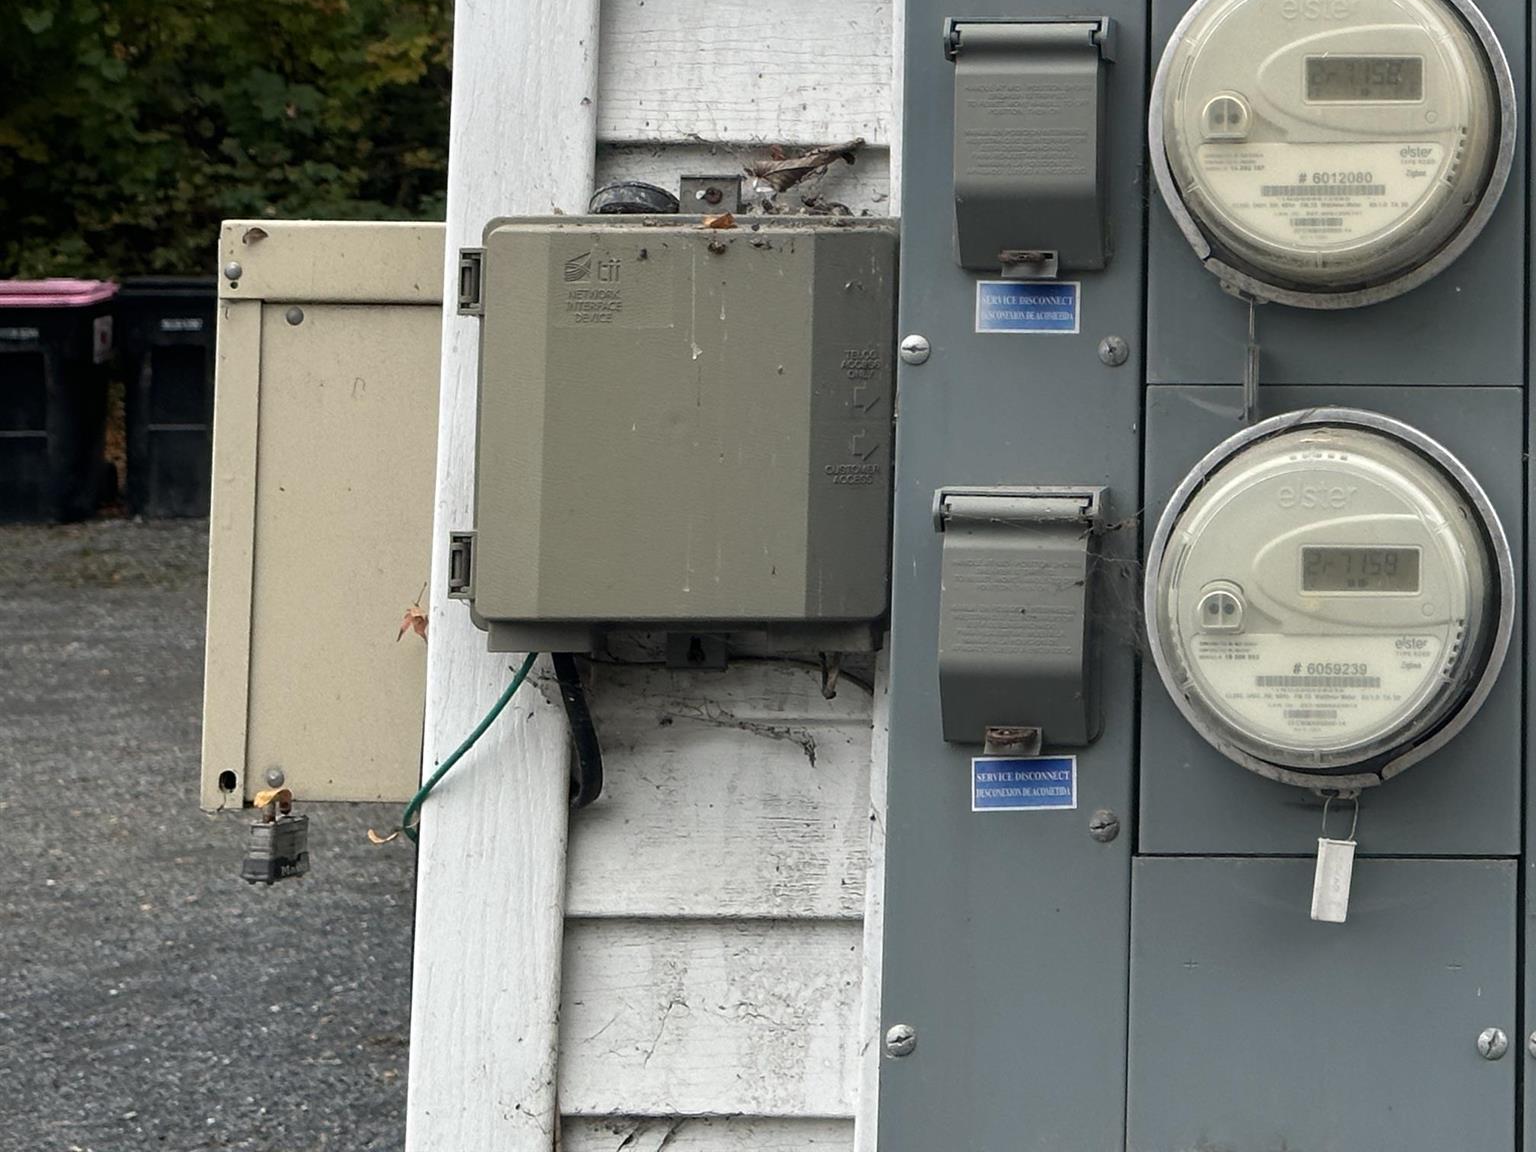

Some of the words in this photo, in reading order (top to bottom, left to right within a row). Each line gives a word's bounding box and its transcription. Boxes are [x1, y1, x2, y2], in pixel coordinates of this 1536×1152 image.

[1400, 145, 1433, 158] elster
[1312, 172, 1373, 184] 6012080
[1019, 296, 1073, 305] DISCONNECT
[575, 313, 613, 324] DEVICE
[824, 464, 880, 475] CUSTOMER
[832, 474, 873, 484] ACCESS
[1395, 635, 1428, 649] elster
[1307, 662, 1367, 676] 6059239
[977, 772, 1013, 782] SERVICE
[1015, 771, 1070, 781] DISCONNECT
